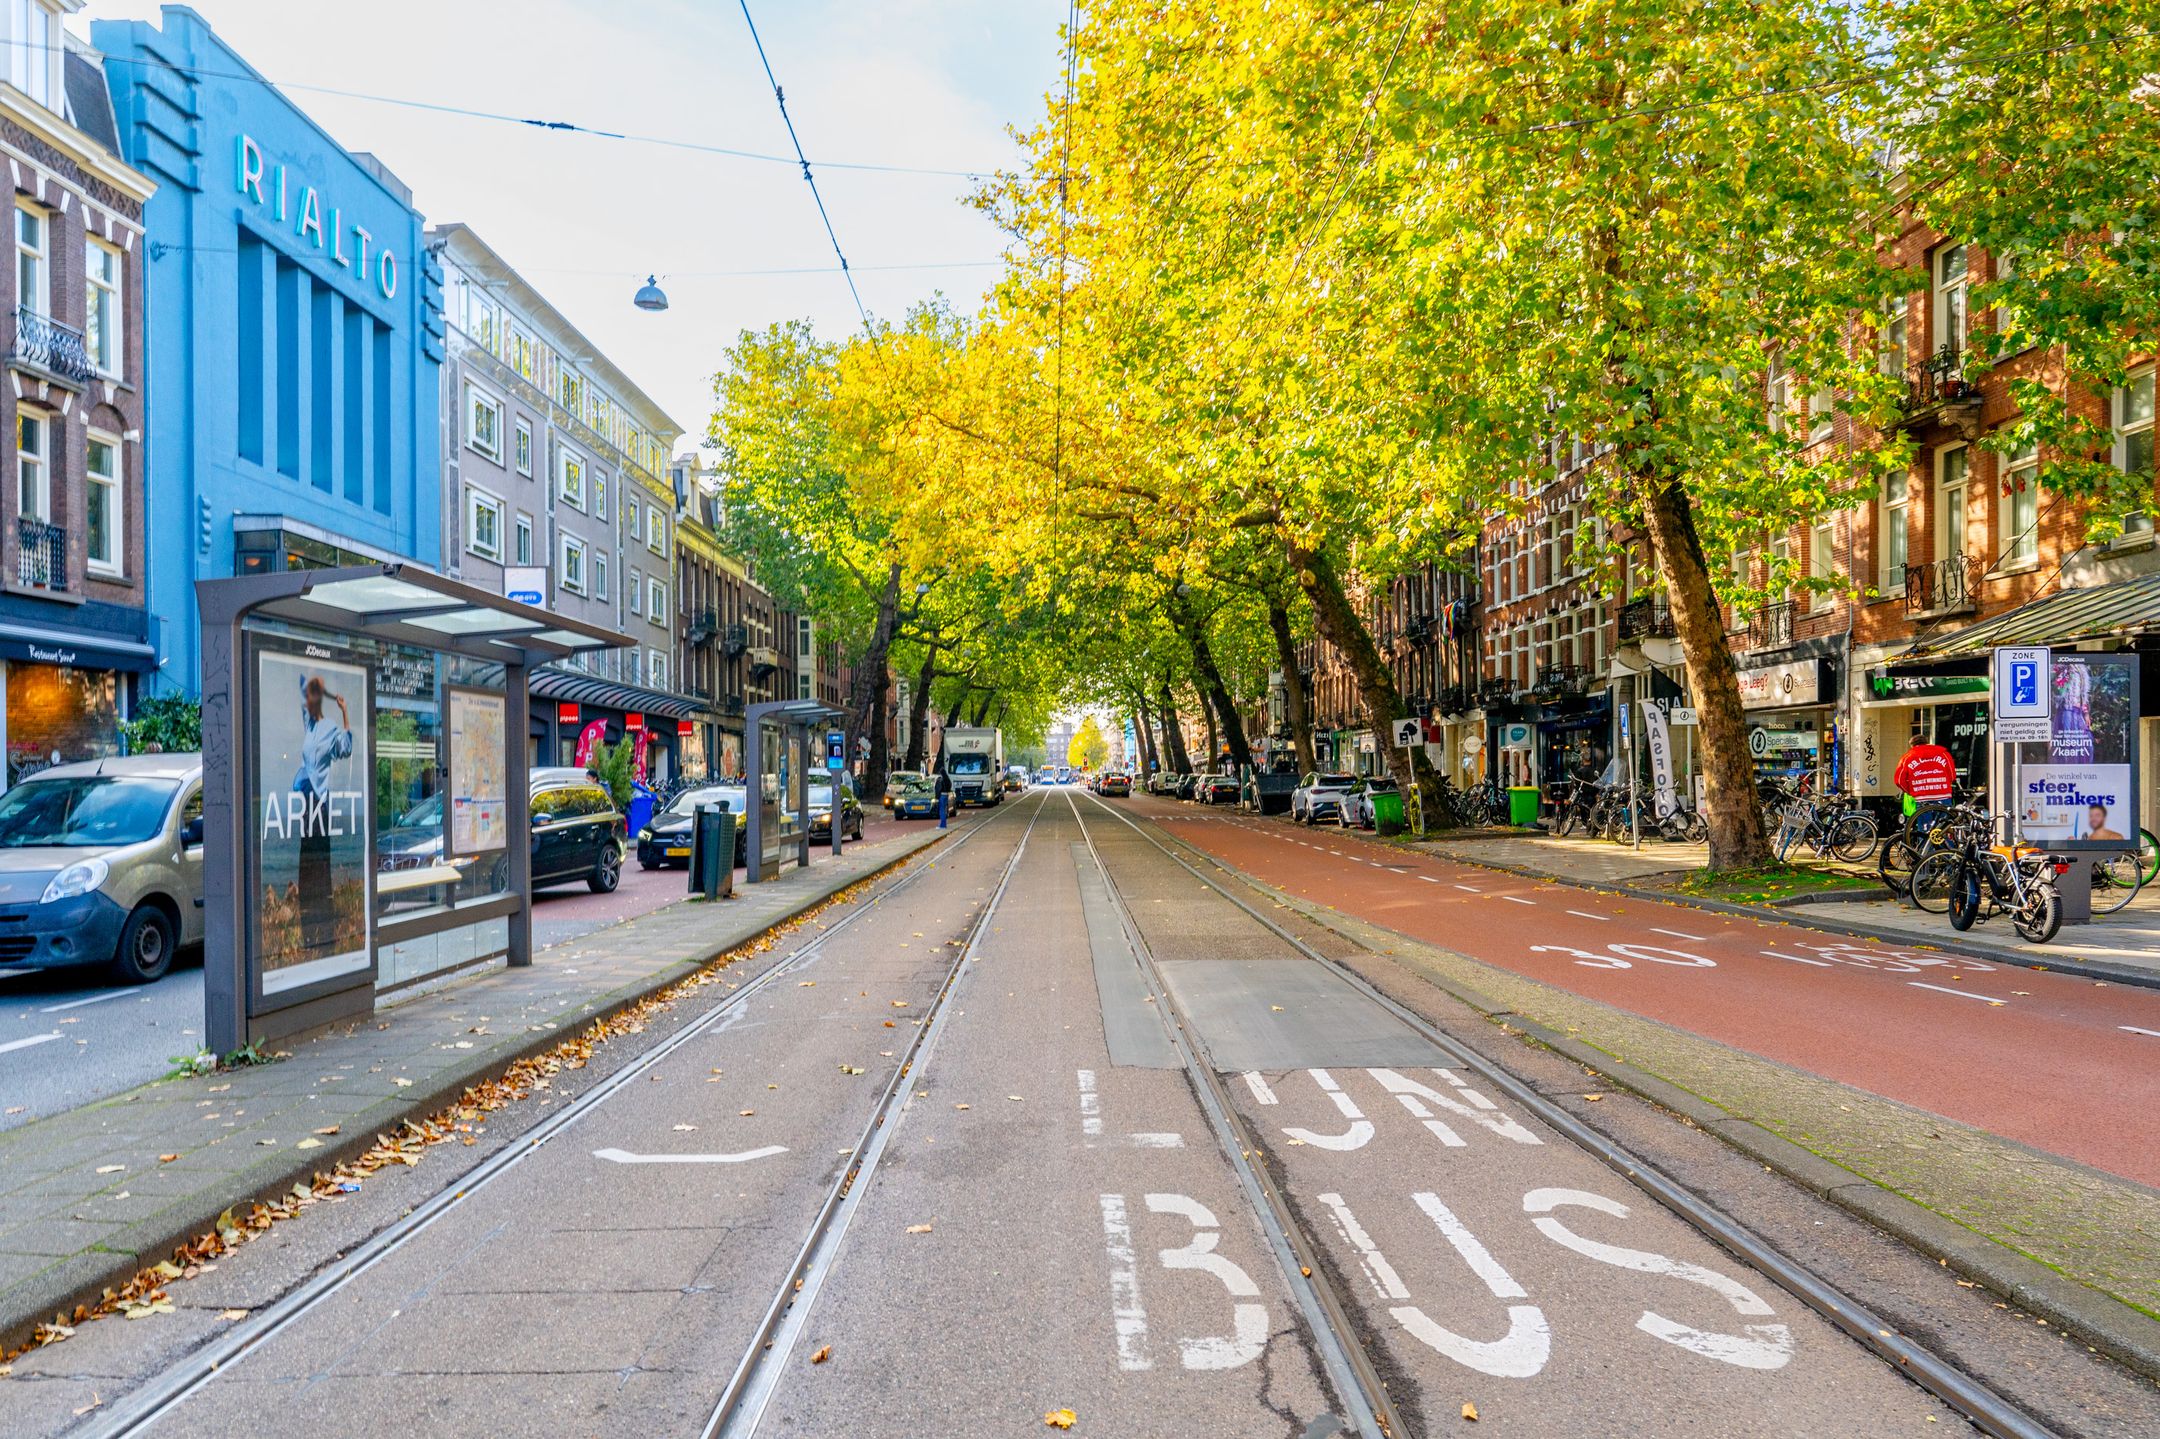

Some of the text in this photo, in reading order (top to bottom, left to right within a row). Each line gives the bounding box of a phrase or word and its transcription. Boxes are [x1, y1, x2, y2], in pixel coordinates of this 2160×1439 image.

[236, 134, 398, 299] RIALTO
[1749, 673, 1768, 691] Leeg?
[2016, 665, 2031, 688] P
[1954, 723, 1988, 736] POP UP
[2000, 721, 2048, 729] vergunningen
[1767, 735, 1799, 747] Specialist
[2050, 739, 2092, 747] museum
[2029, 779, 2076, 793] sfeer
[2046, 791, 2115, 806] makers
[264, 791, 362, 840] ARKET
[1530, 944, 1717, 969] 30
[1100, 1187, 1794, 1379] BUS
